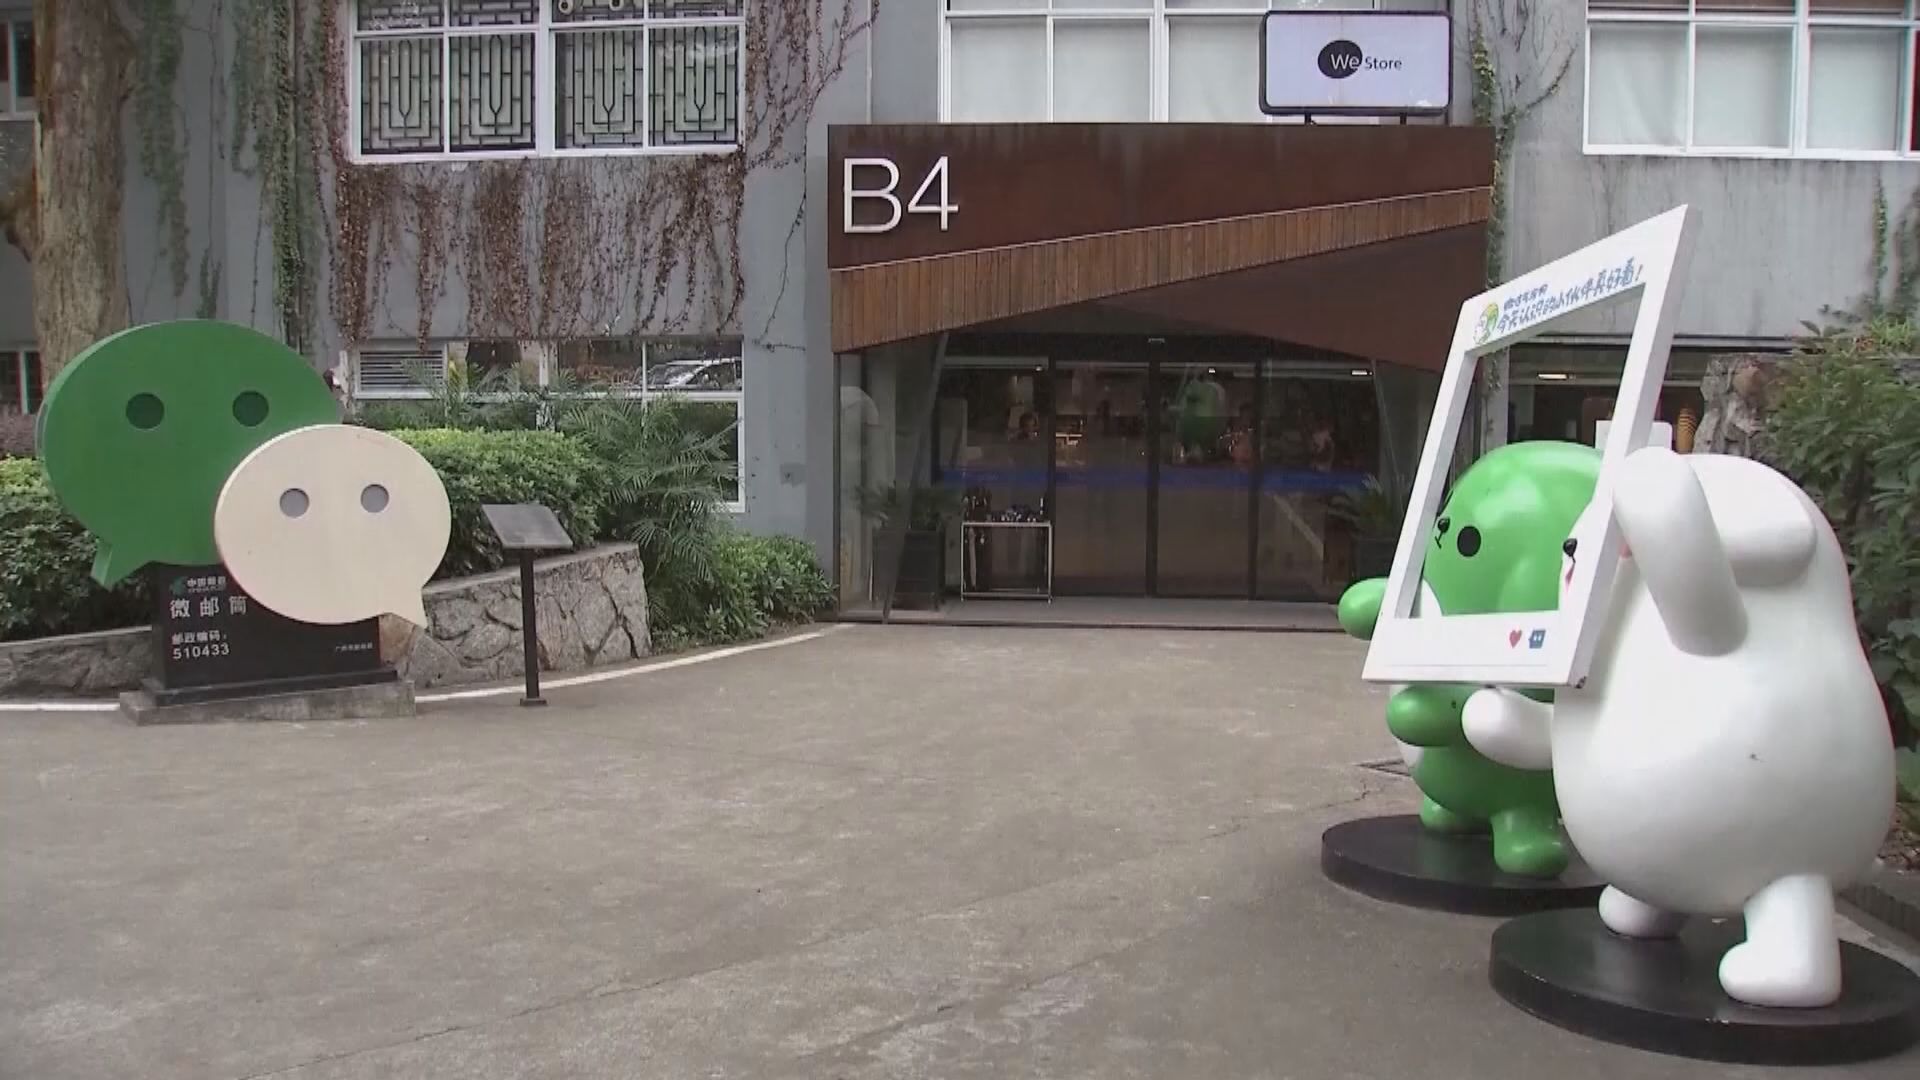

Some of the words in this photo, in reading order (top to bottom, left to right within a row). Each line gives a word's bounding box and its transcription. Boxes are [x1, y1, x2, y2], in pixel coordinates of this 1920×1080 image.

[1330, 53, 1360, 71] We
[1364, 56, 1403, 71] Store
[843, 155, 960, 234] B4
[172, 642, 230, 660] 510433
